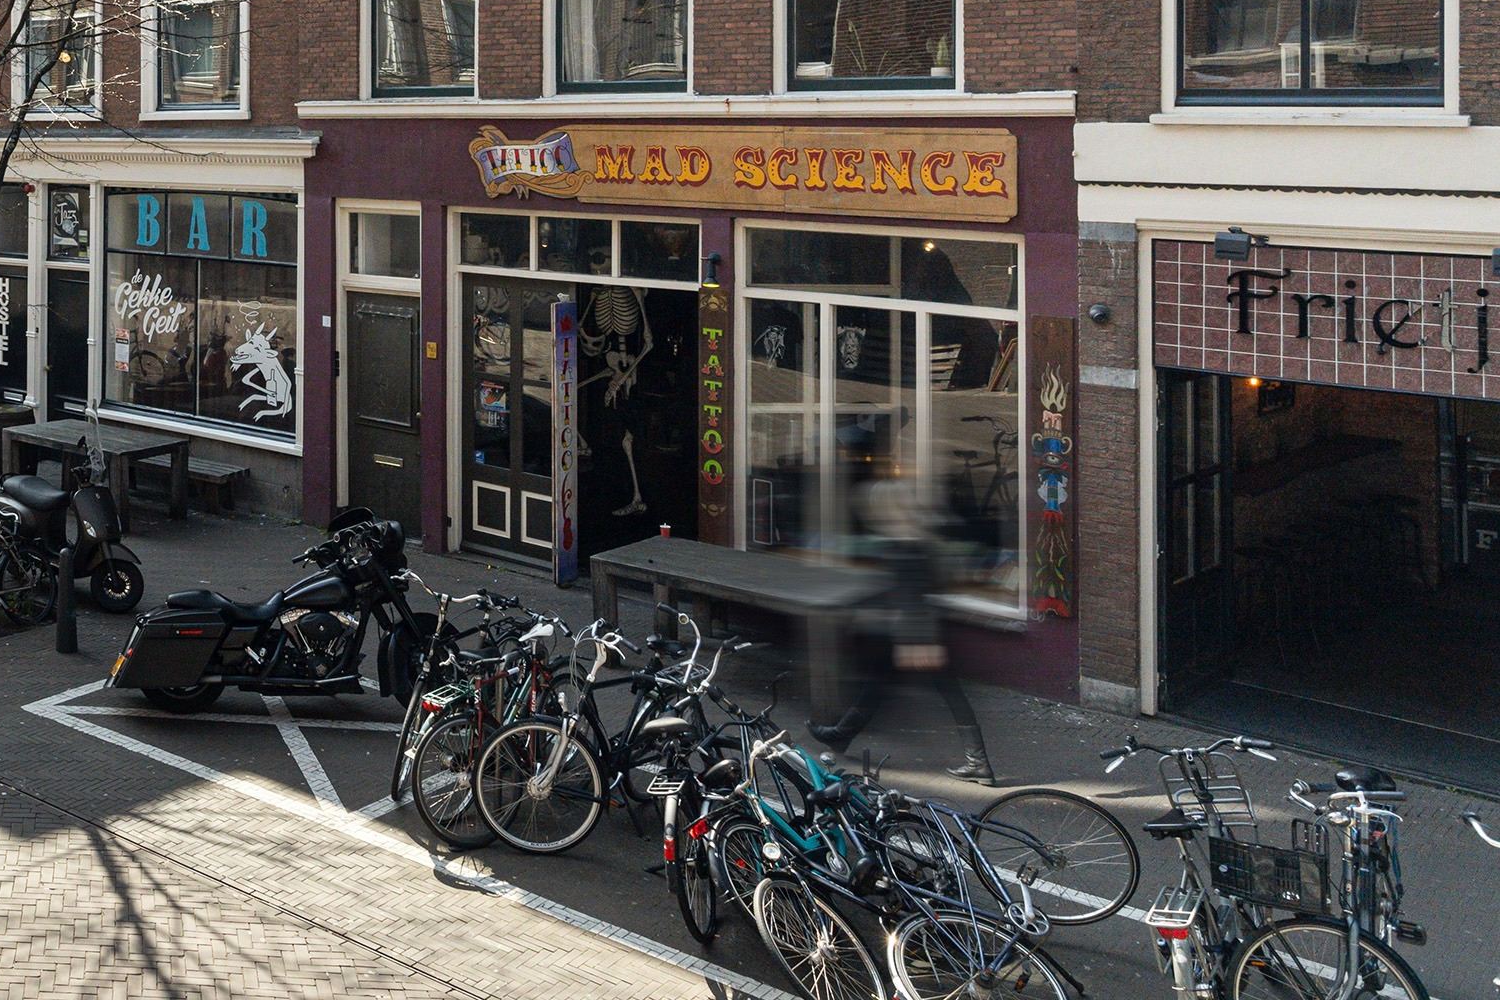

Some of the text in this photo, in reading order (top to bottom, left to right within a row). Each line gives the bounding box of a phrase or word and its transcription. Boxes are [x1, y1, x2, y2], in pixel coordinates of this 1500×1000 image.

[593, 144, 1009, 198] MAD SCIENCE
[136, 194, 268, 257] BAR
[115, 273, 173, 320] Gekke
[131, 268, 143, 284] de
[143, 302, 187, 343] Geit
[560, 337, 574, 472] TATTOO
[701, 327, 725, 485] TATTOO
